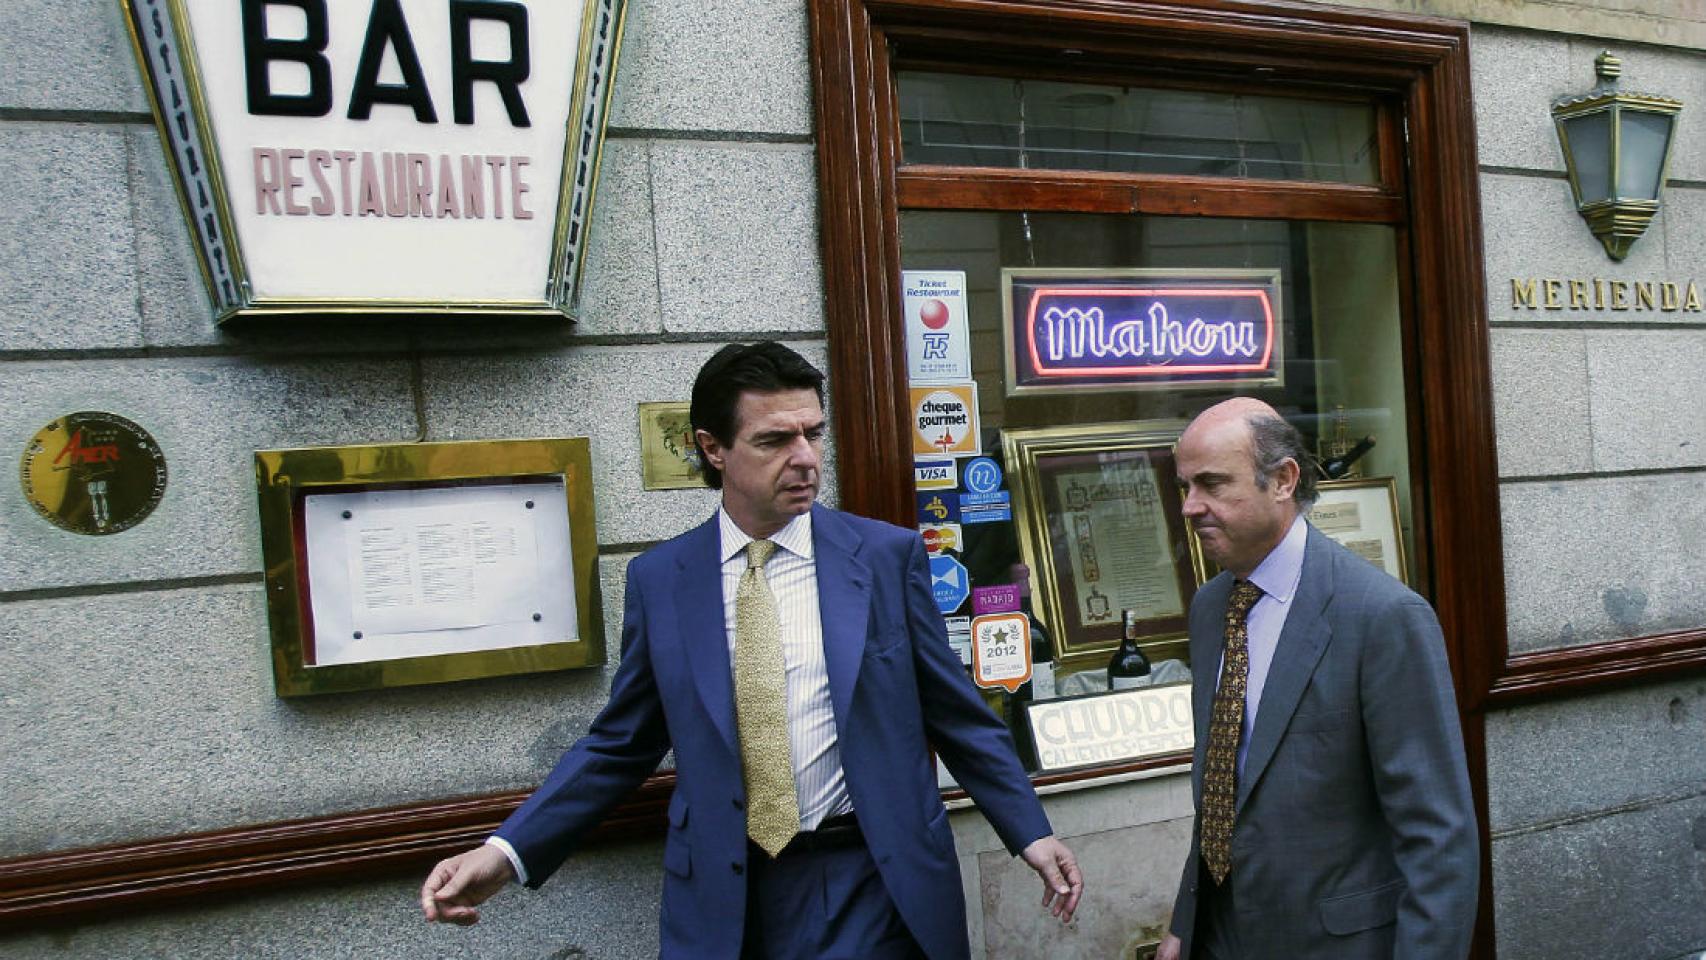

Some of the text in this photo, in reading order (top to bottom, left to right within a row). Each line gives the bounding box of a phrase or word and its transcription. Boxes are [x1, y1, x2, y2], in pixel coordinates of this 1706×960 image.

[241, 0, 531, 127] BAR
[147, 0, 234, 306] STAURANTE
[253, 147, 534, 220] RESTAURANTE
[919, 280, 947, 288] Ticket
[907, 288, 960, 297] Restaurant
[1044, 302, 1258, 360] Mahou
[922, 401, 962, 414] cheque
[919, 414, 967, 429] gourmet
[920, 468, 947, 480] VISA
[987, 645, 1016, 658] 2012
